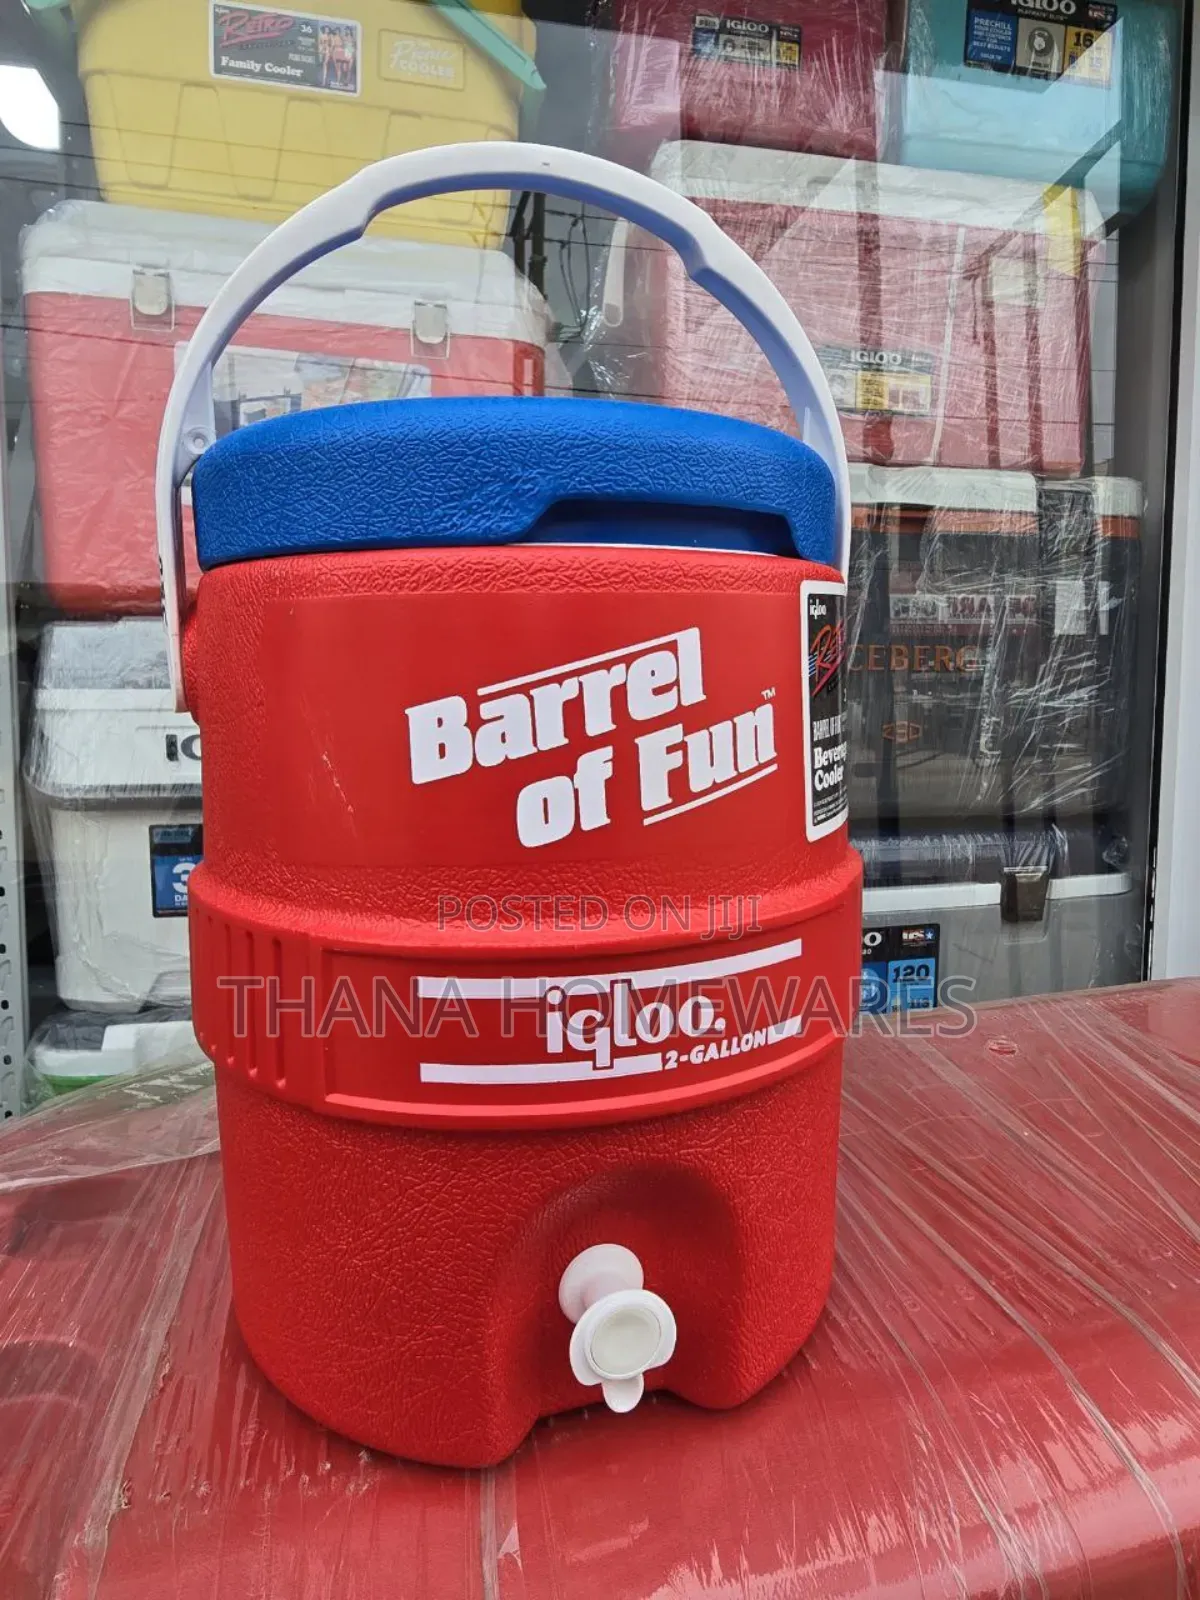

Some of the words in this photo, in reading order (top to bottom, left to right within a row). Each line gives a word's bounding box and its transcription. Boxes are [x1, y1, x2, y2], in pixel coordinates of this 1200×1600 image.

[726, 19, 769, 33] IGLOO
[220, 56, 262, 72] Family
[264, 63, 304, 77] Cooler
[850, 350, 902, 365] IGLOO
[405, 627, 706, 785] Barrel
[516, 745, 613, 848] of
[635, 703, 777, 811] Fun
[814, 763, 844, 791] Cooler
[892, 963, 931, 983] 120
[664, 1028, 767, 1070] 2-GALLON
